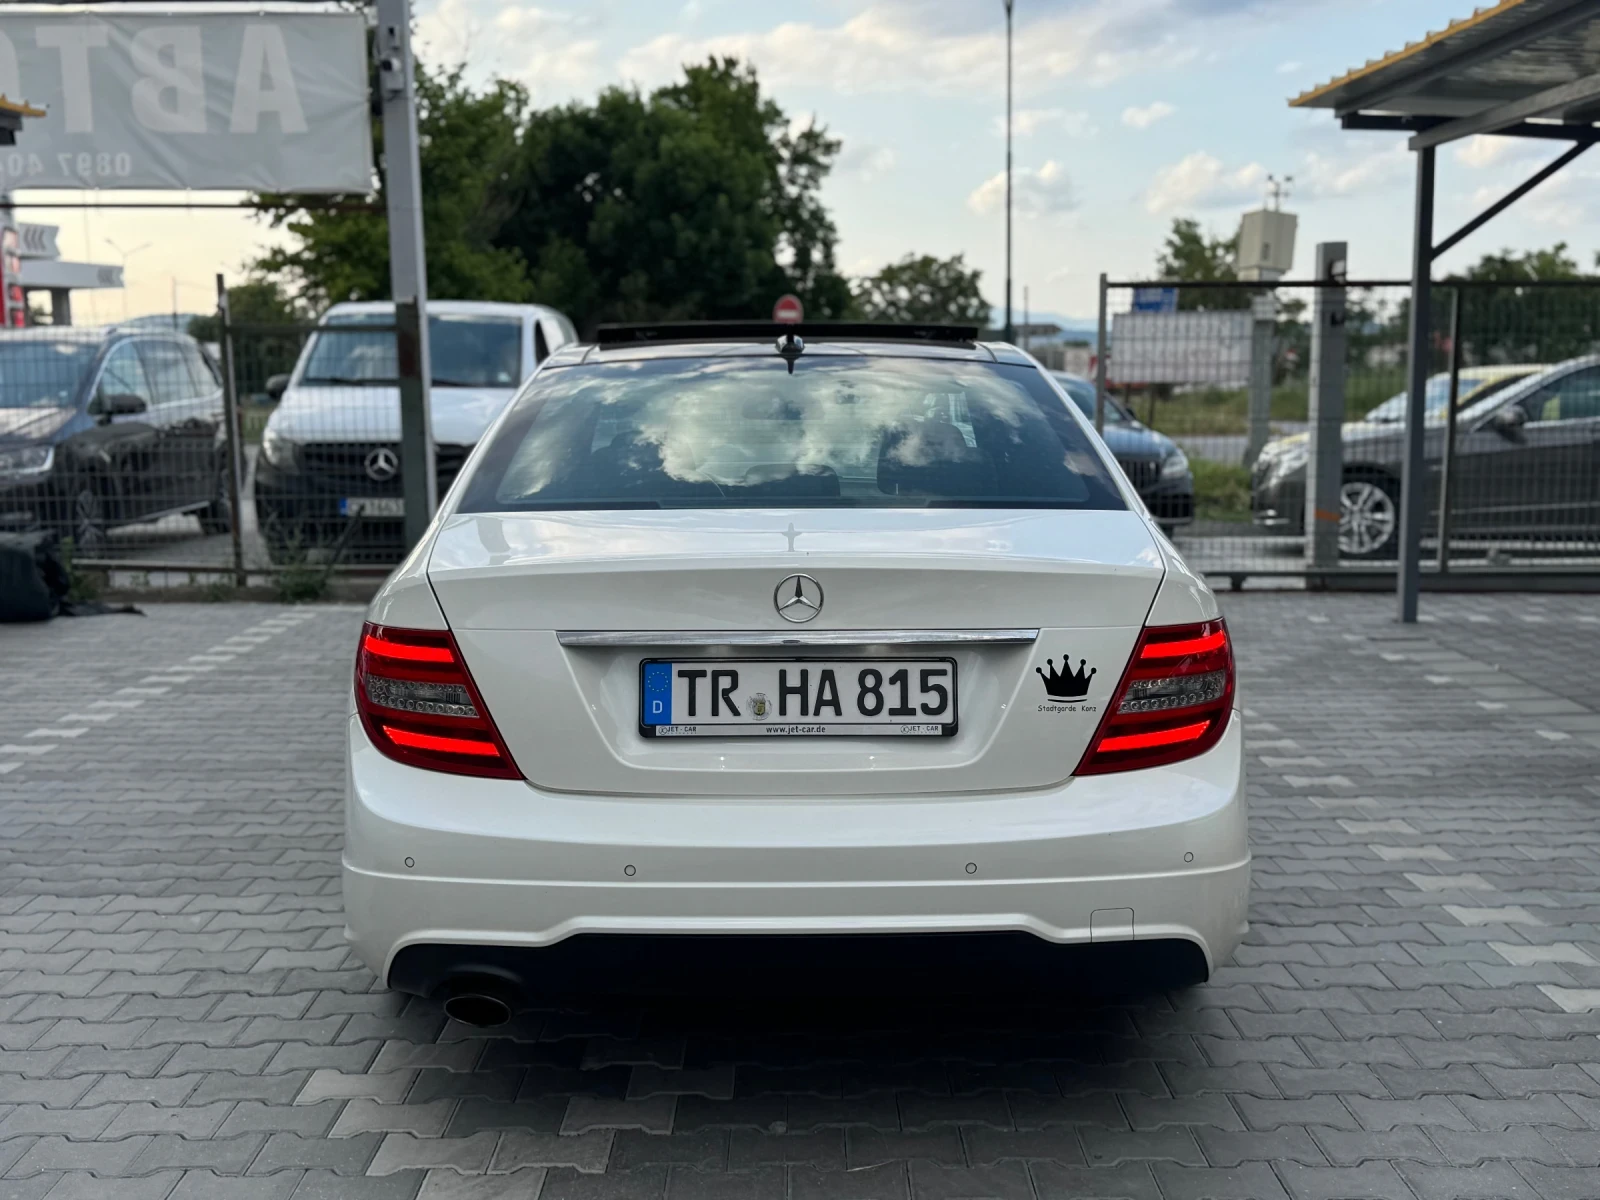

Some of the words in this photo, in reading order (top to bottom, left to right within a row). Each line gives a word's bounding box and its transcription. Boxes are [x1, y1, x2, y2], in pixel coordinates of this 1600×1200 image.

[677, 669, 742, 717] TR
[778, 668, 843, 717] HA
[856, 668, 948, 717] 815
[652, 700, 663, 714] D
[1037, 704, 1077, 714] Stadtgarde
[1081, 704, 1097, 712] Konz
[765, 725, 826, 735] www.jet-car.de
